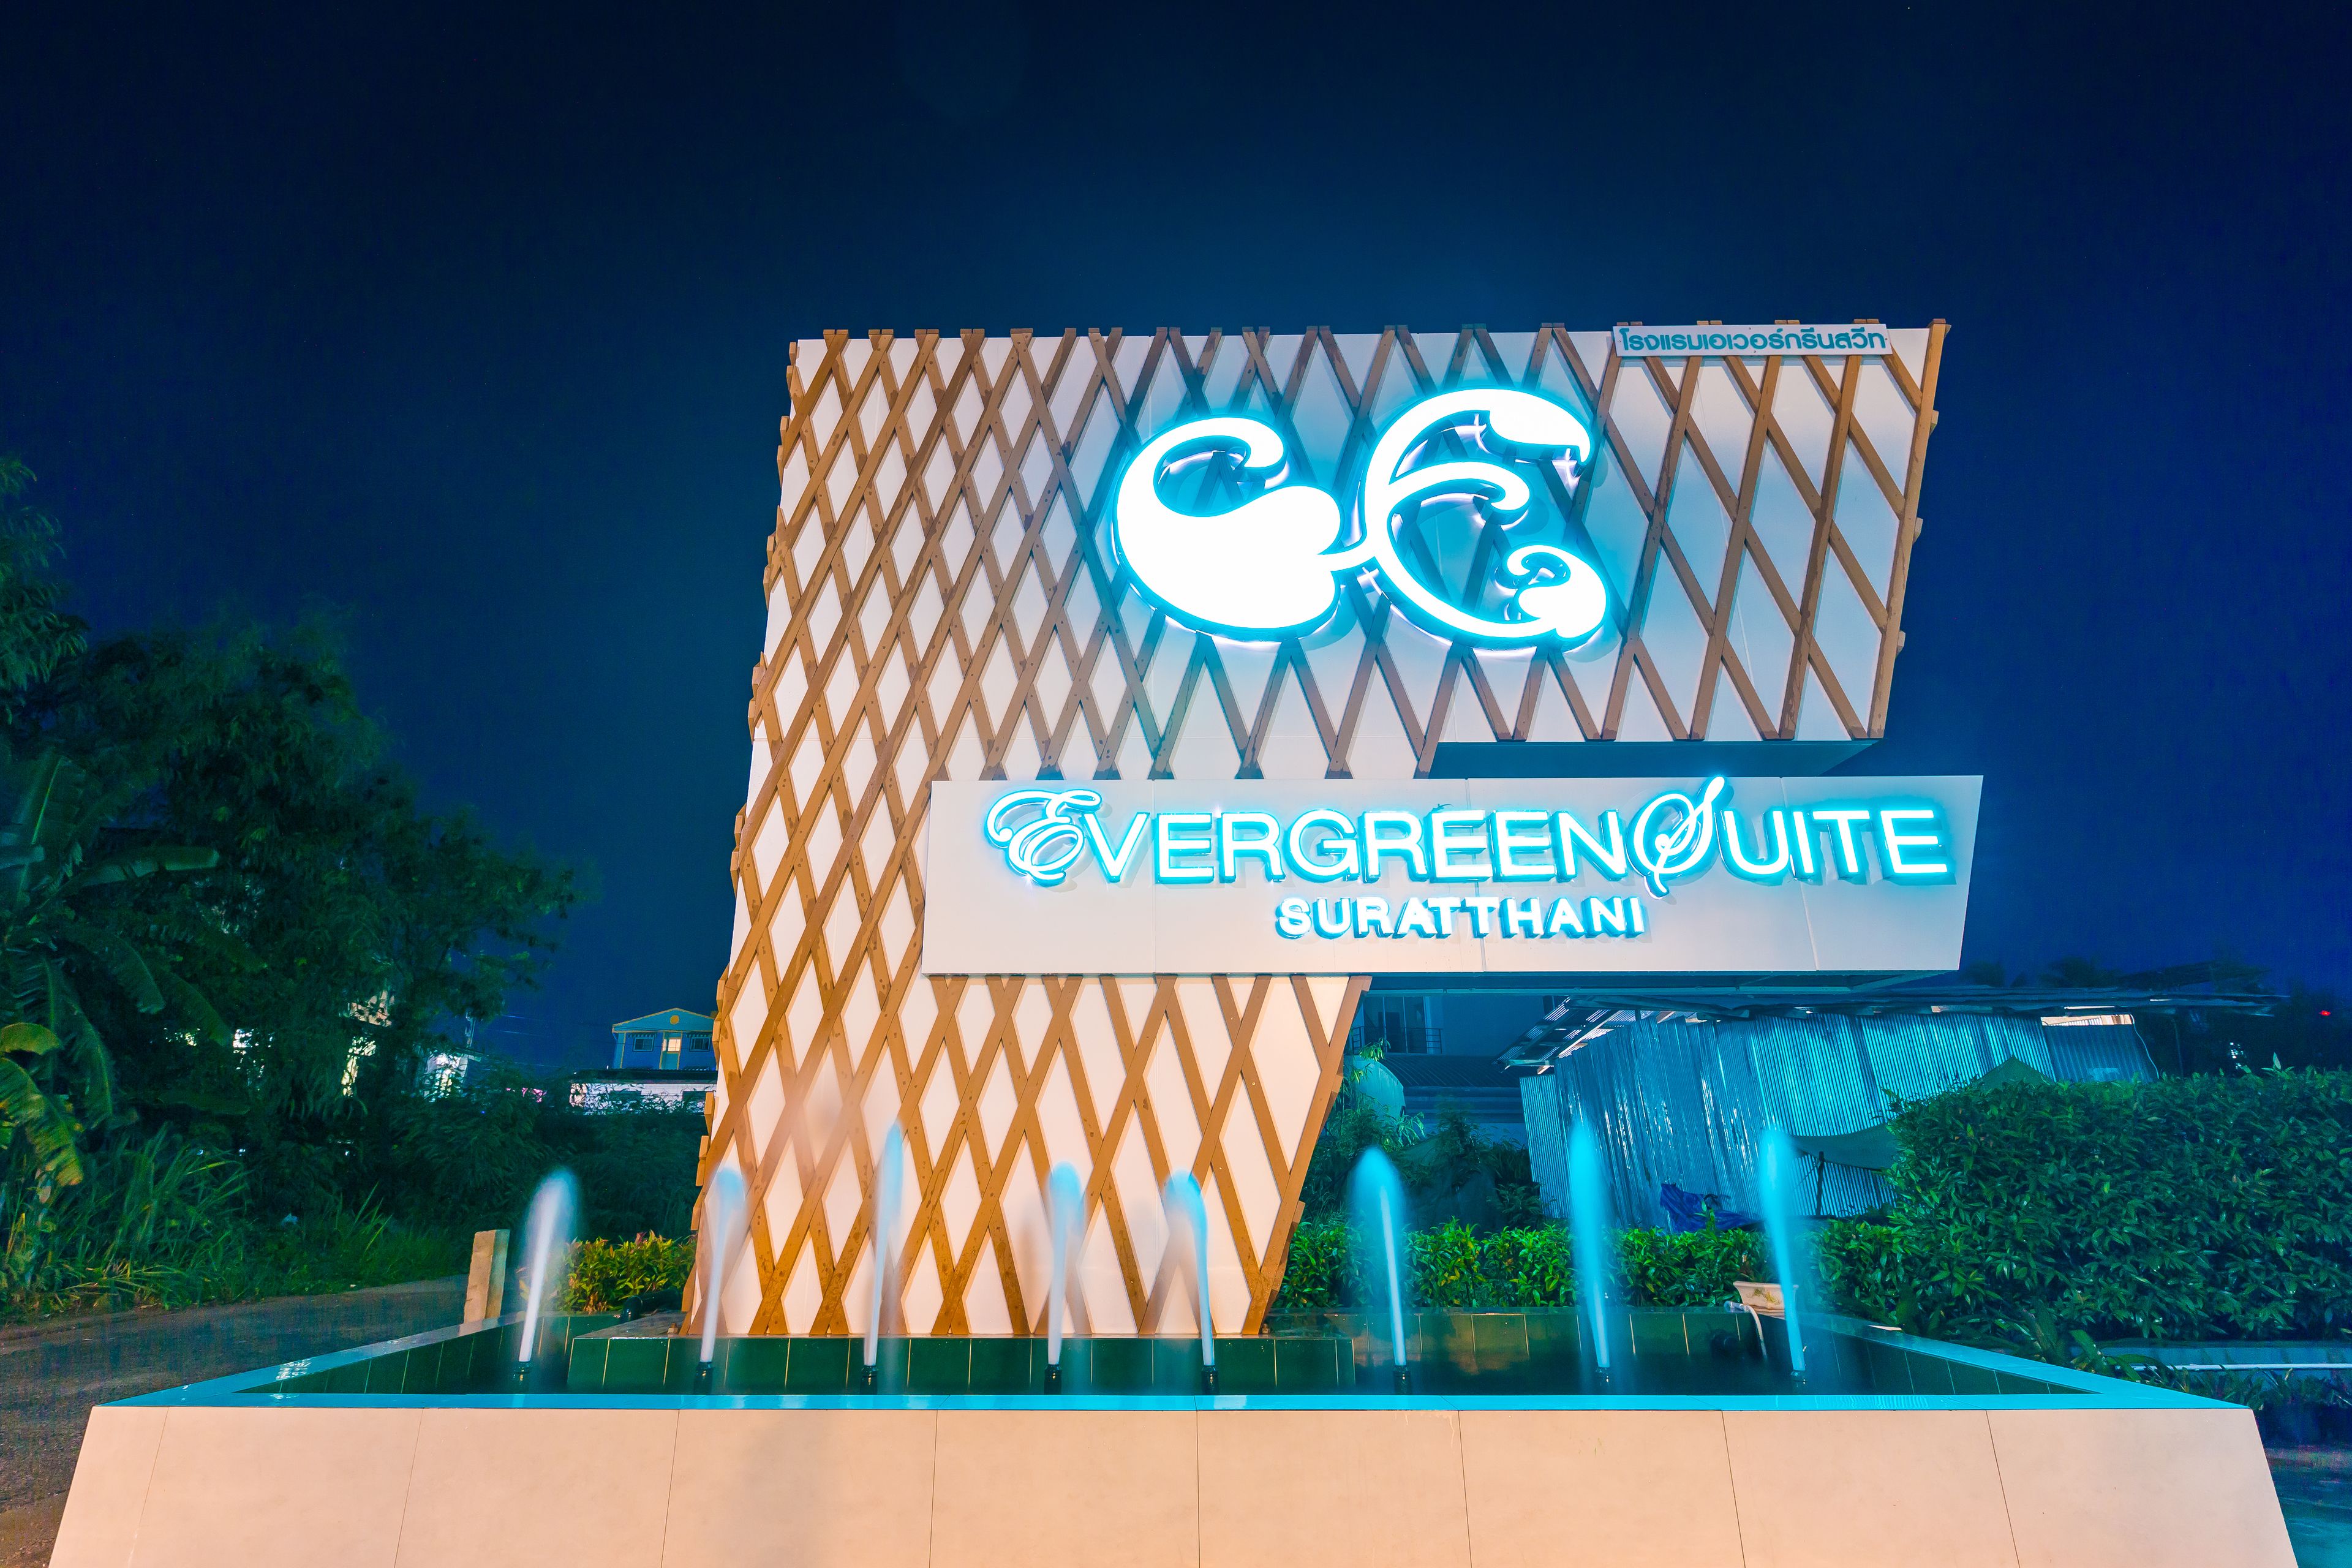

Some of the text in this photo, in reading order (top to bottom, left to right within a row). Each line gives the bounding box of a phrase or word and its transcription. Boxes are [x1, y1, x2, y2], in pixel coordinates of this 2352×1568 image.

[1619, 327, 1887, 351] โรงแรมเอเวอร์กรีนสวีท
[985, 775, 1949, 899] EVERGREEN SUITE
[1276, 896, 1645, 940] SURATTHANI
